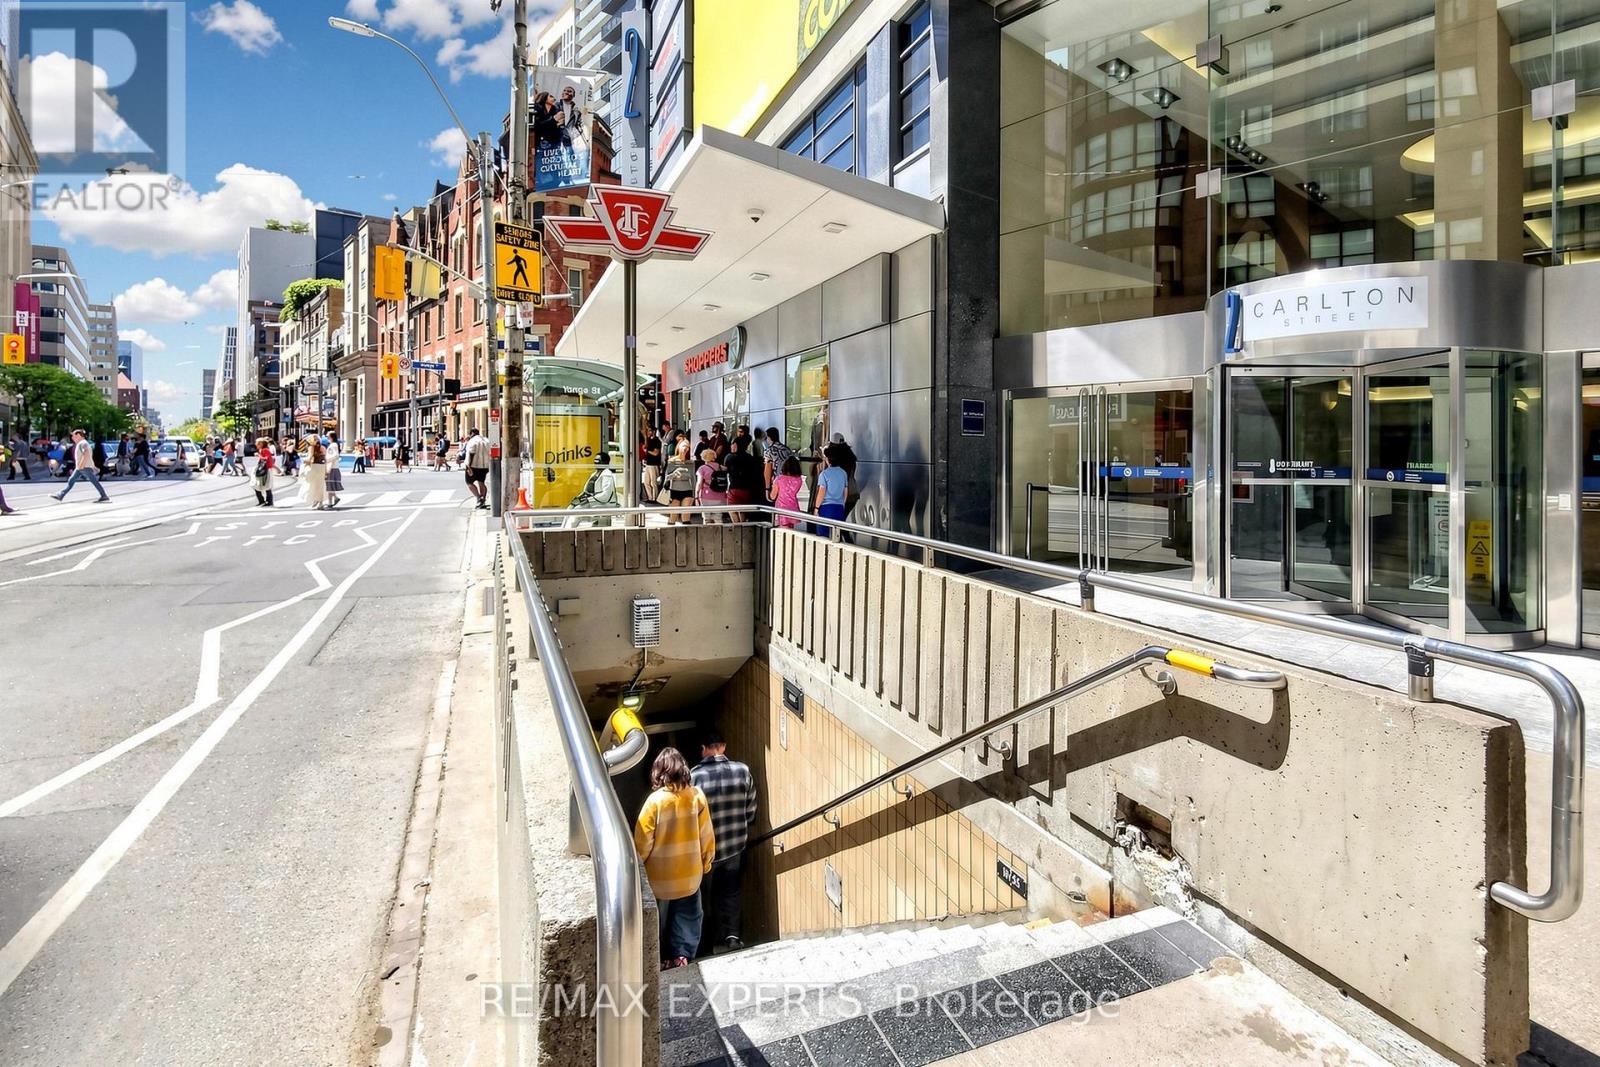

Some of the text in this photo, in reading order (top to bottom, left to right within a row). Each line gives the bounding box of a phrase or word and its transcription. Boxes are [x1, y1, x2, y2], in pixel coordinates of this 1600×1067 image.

[803, 0, 854, 48] CO
[503, 226, 533, 239] SENIORS
[496, 233, 540, 250] SAFETY ZONE
[496, 289, 515, 299] DRIVE
[1253, 286, 1414, 318] CARLTON
[1283, 311, 1373, 327] STREET
[683, 343, 728, 376] SHOPPERS
[563, 385, 601, 395] Yonge St
[545, 444, 593, 465] Drinks
[214, 519, 359, 531] STOP
[193, 534, 316, 548] TTC
